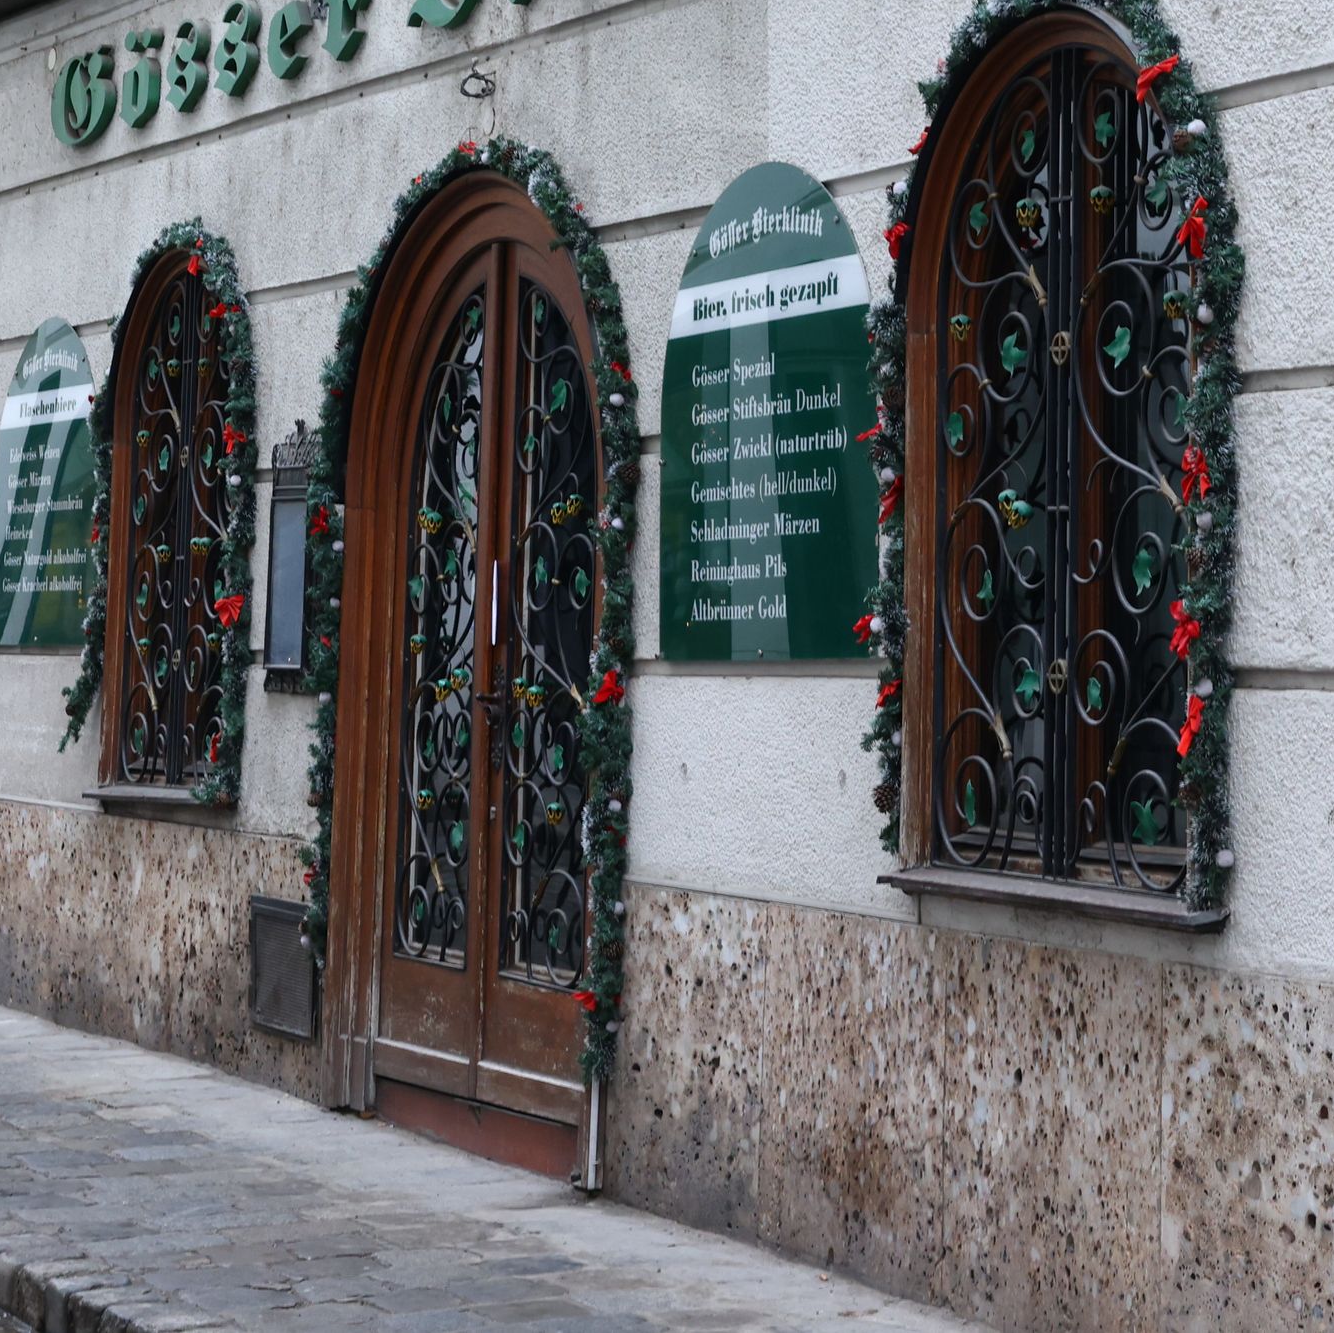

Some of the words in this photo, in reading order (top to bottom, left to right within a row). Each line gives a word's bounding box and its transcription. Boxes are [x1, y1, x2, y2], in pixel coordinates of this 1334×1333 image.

[752, 206, 824, 243] Bierklinik
[731, 284, 775, 314] frisch
[780, 271, 838, 311] gezapft
[692, 365, 730, 387] Gösser
[733, 352, 775, 386] Spezial
[20, 397, 76, 418] Flaschenbiere
[691, 403, 730, 426] Gösser
[733, 392, 791, 420] Stiftsbräu
[796, 383, 841, 412] Dunkel
[9, 447, 37, 464] Edelweiss
[691, 442, 729, 465] Gösser
[733, 433, 771, 460] Zwickl
[775, 425, 847, 459] (naturtrüb)
[8, 474, 27, 489] Gösser
[29, 471, 51, 486] Märzen
[691, 477, 755, 504] Gemischtes
[759, 466, 837, 503] (hell/dunkel)
[7, 498, 45, 516] Wieselburger
[47, 494, 83, 511] Stammbräu
[5, 524, 33, 541] Heineken
[691, 517, 769, 545] Schladminger
[774, 512, 820, 536] Märzen
[4, 551, 22, 566] Gösser
[53, 548, 87, 564] alkoholfrei
[691, 556, 761, 586] Reininghaus
[765, 553, 787, 577] Pils
[3, 578, 20, 592] Gösser
[49, 575, 83, 592] alkoholfrei
[691, 598, 754, 621] Altbrünner
[758, 594, 787, 619] Gold
